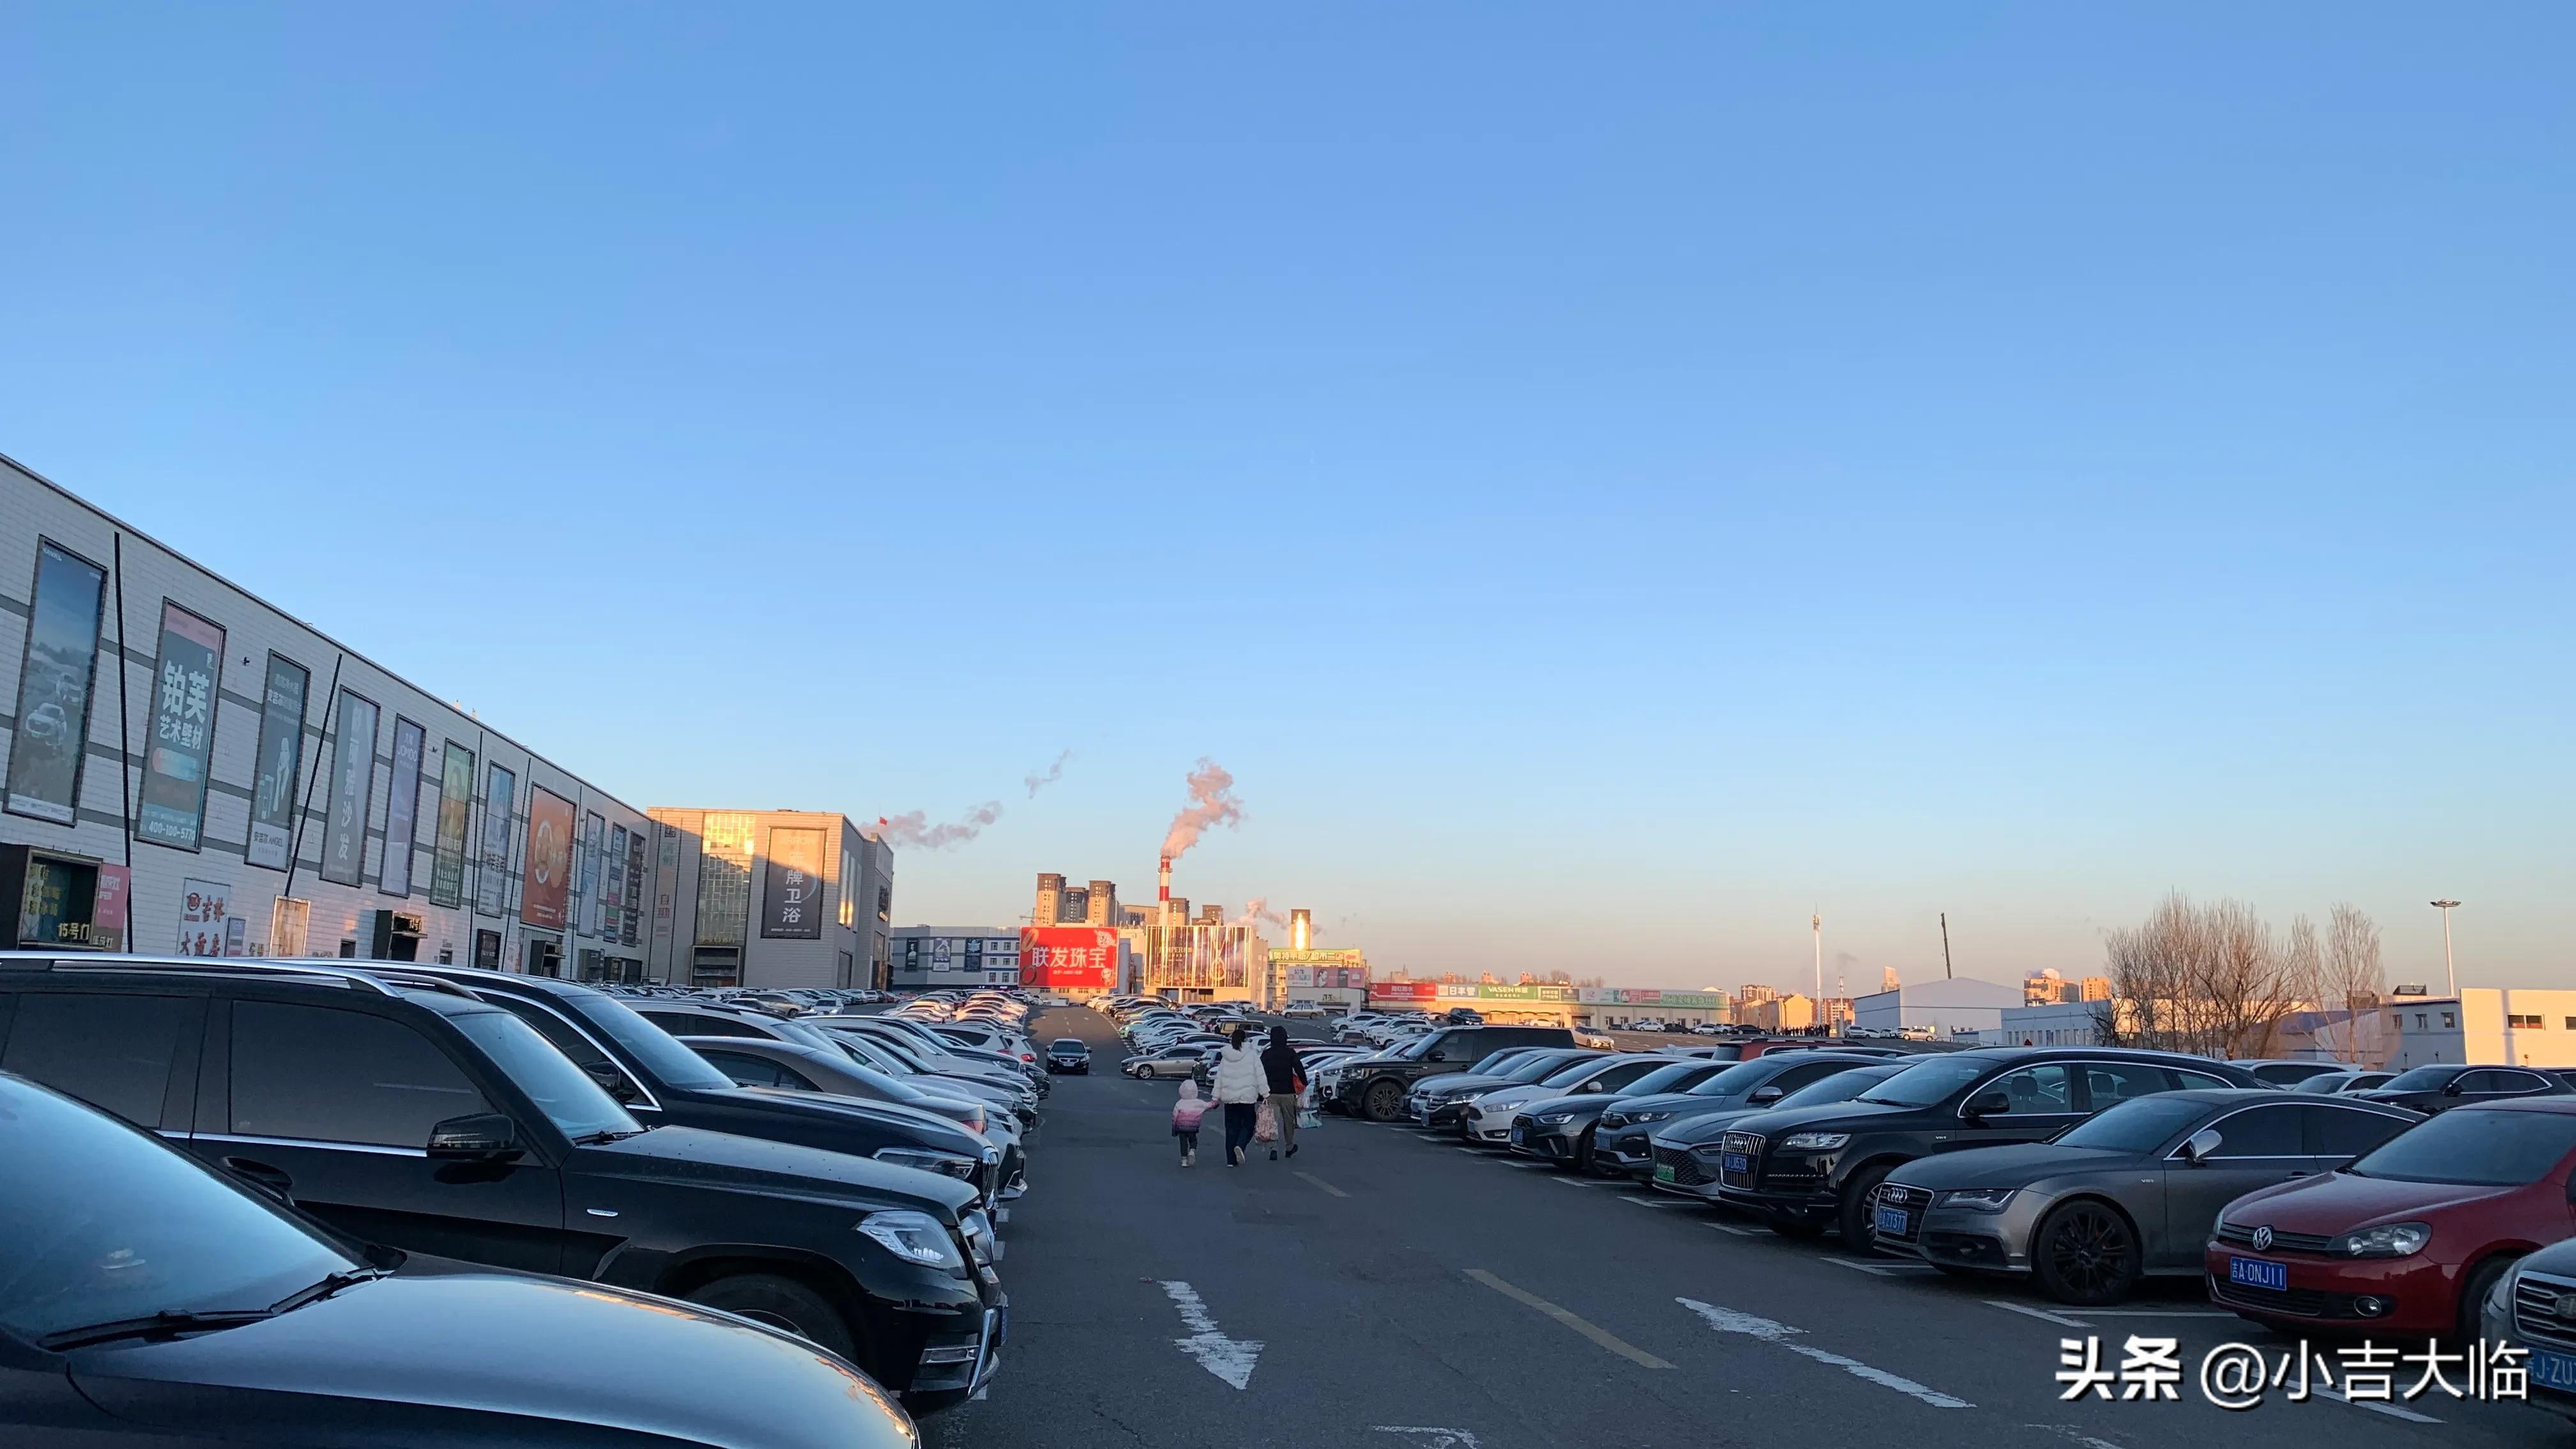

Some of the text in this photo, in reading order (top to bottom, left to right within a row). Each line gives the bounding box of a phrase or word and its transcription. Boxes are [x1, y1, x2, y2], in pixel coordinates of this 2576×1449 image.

[162, 659, 210, 724] 铂芙
[159, 715, 203, 750] 艺术壁材
[396, 745, 417, 762] JOMOO
[57, 923, 90, 940] 15号门
[1032, 946, 1107, 969] 联发珠宝
